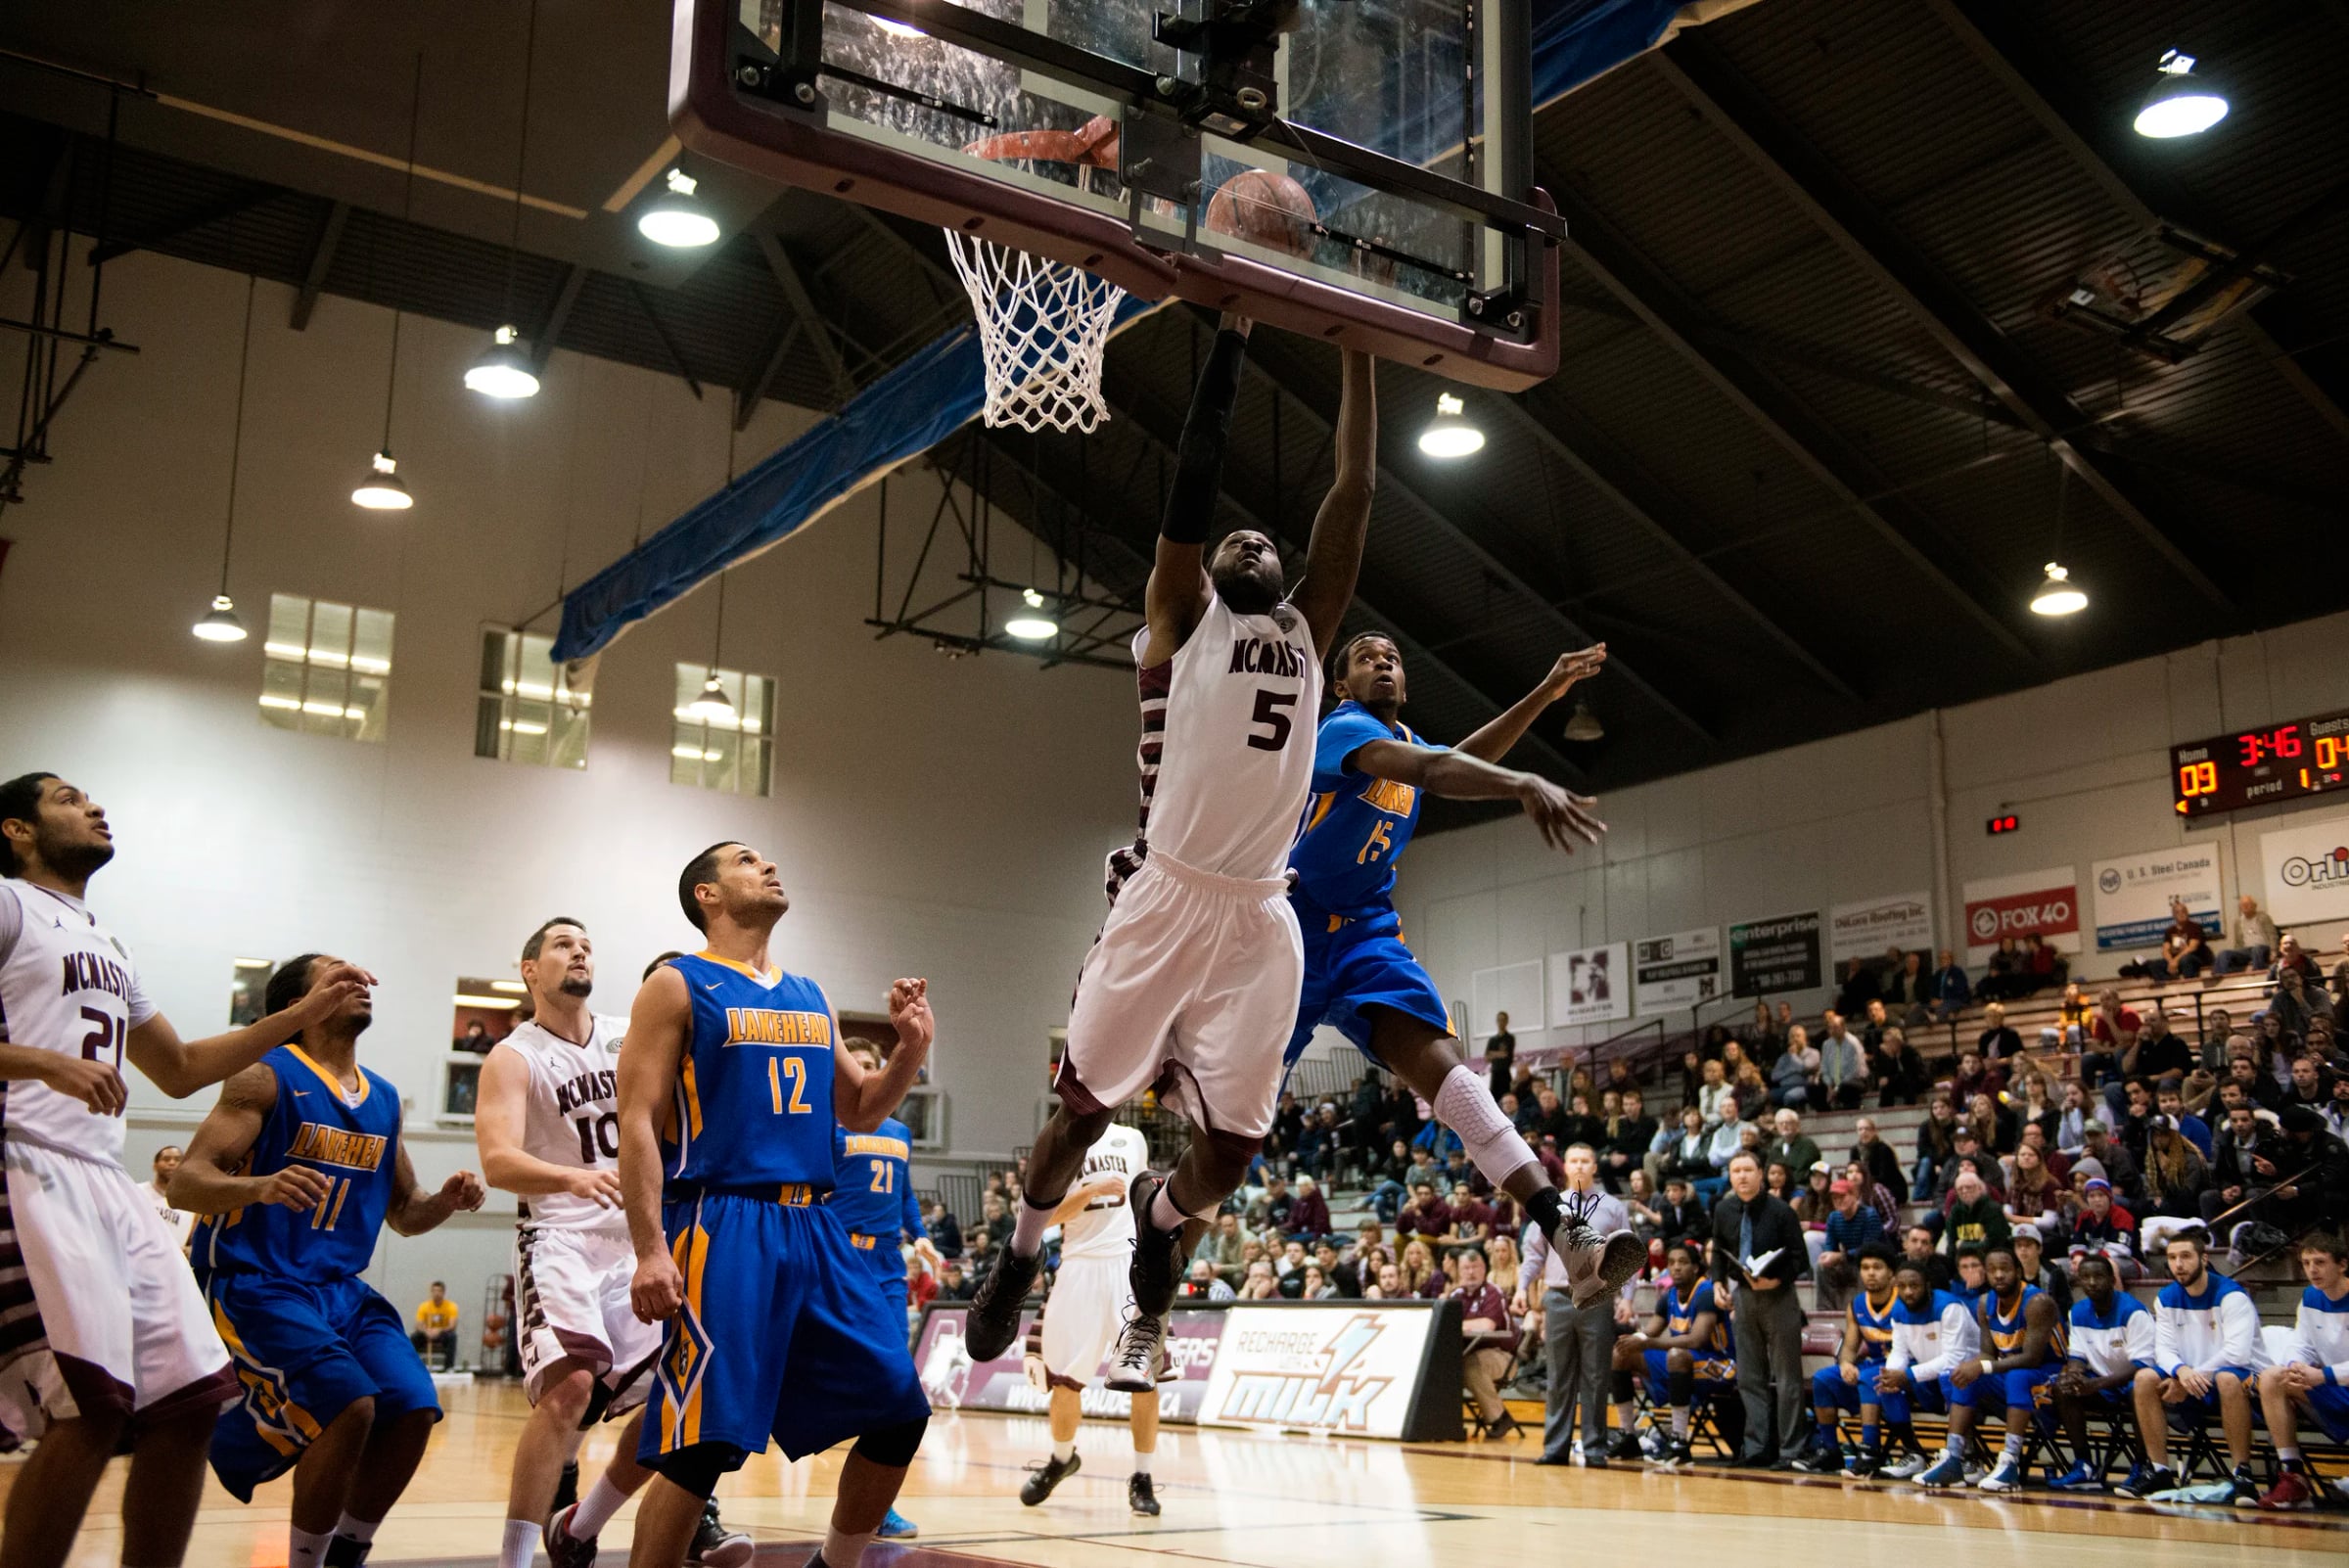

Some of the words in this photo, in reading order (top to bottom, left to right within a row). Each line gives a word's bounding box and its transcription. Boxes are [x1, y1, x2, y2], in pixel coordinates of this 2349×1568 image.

[1228, 638, 1306, 678] MCMAST
[1247, 689, 1298, 752] 5
[2310, 718, 2349, 736] Guests
[2179, 748, 2208, 763] Home
[2238, 725, 2302, 767] 3:46
[2180, 761, 2218, 797] 09
[2246, 779, 2282, 800] period
[1357, 820, 1394, 864] 15
[2151, 862, 2175, 876] Steel
[2176, 858, 2211, 872] Canada
[2281, 847, 2349, 887] Orli
[1730, 917, 1819, 943] enterprise
[2001, 905, 2041, 931] FOX
[2041, 901, 2070, 924] 40
[62, 950, 132, 1002] MCMAST
[80, 1005, 125, 1072] 21
[722, 1007, 831, 1050] LAKEHEAD
[556, 1070, 619, 1117] MCMAST
[768, 1057, 812, 1114] 12
[284, 1122, 389, 1173] LAKEHEA
[576, 1112, 620, 1164] 10
[870, 1159, 894, 1193] 21
[1077, 1155, 1128, 1182] CMASTER
[311, 1176, 351, 1231] 11
[1236, 1331, 1318, 1355] RECHARGE
[1218, 1369, 1397, 1431] MILK
